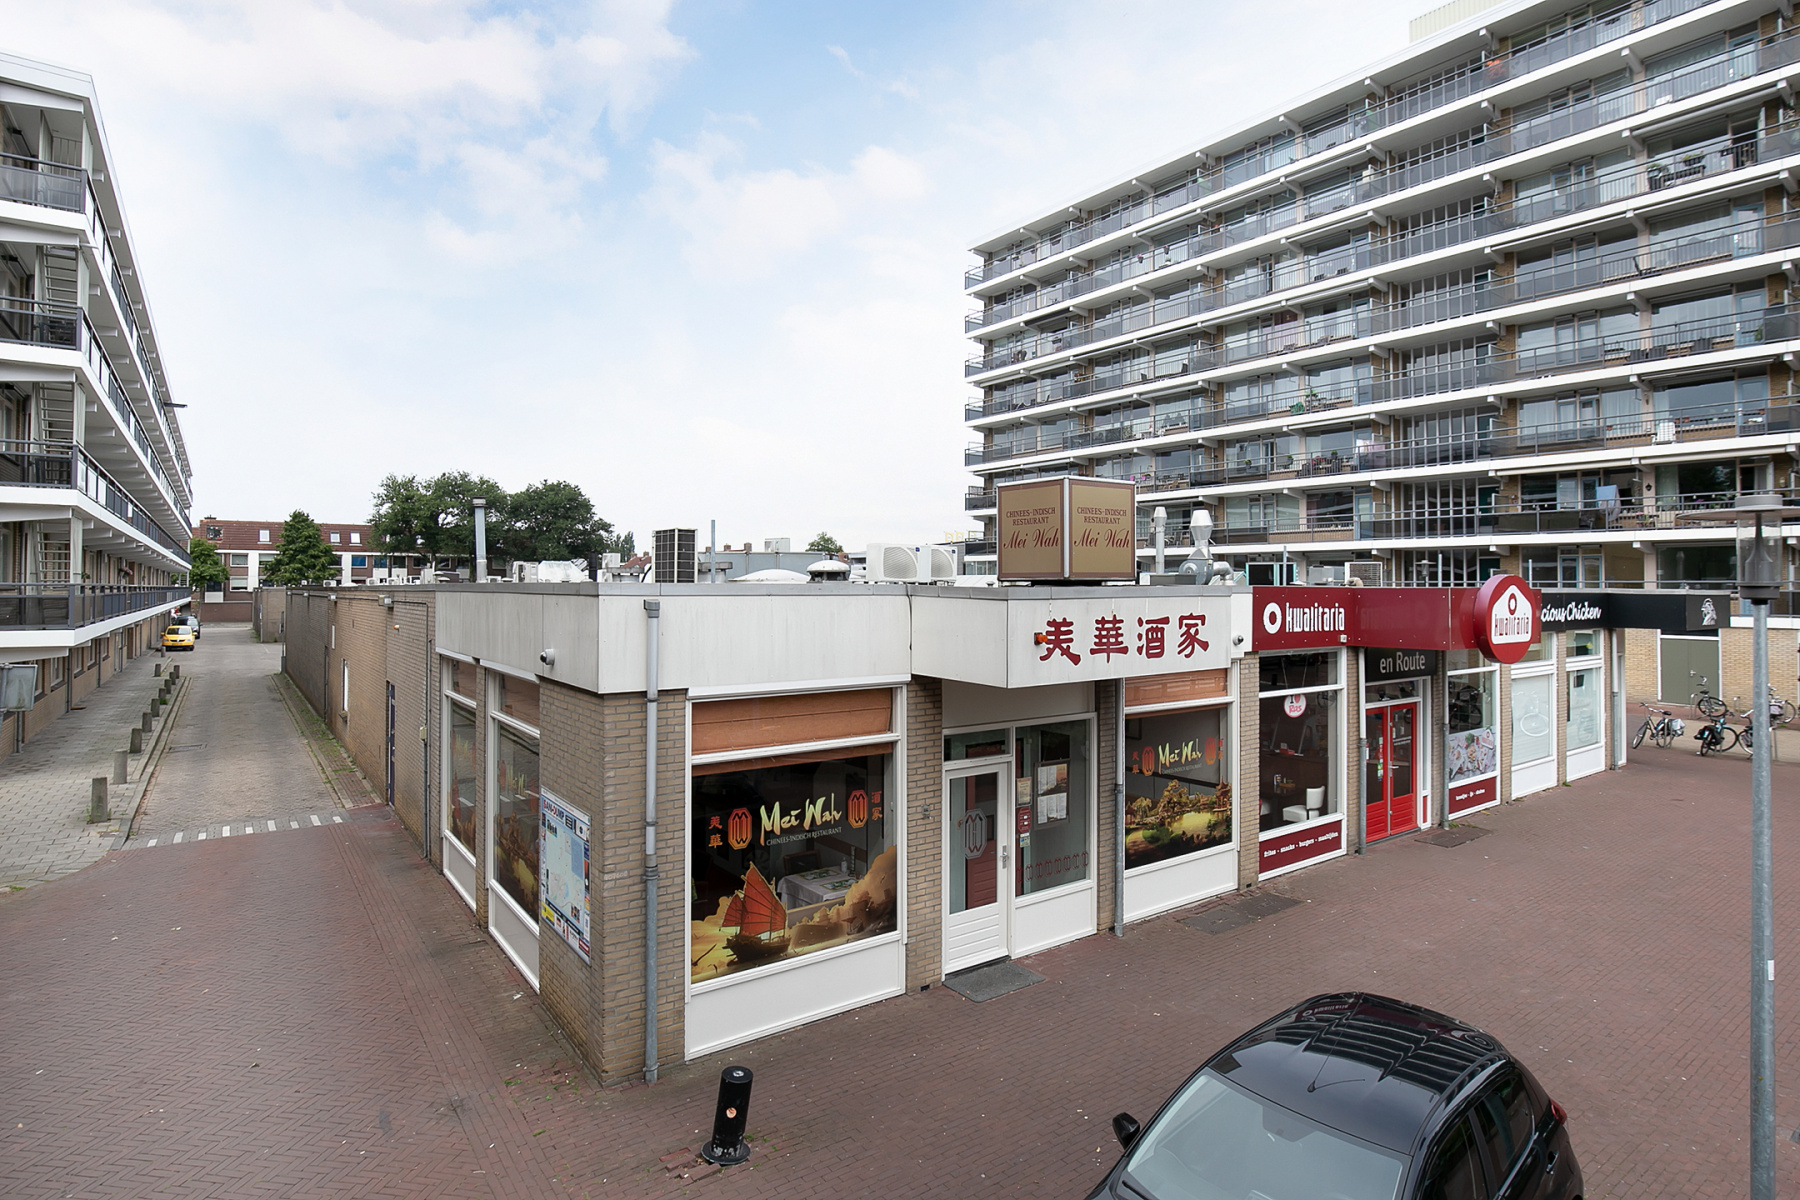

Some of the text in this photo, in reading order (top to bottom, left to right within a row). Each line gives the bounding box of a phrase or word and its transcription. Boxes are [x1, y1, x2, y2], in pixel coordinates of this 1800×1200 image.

[1005, 506, 1056, 518] CHINEES-INDISCH
[1012, 516, 1050, 526] RESTAURANT
[1076, 506, 1127, 517] CHINEES-INDISCH
[1084, 516, 1121, 525] RESTAURANT
[1003, 526, 1059, 550] Mei Wah
[1074, 527, 1130, 548] Mei Wah
[1285, 602, 1345, 633] kwalitaria
[1566, 601, 1602, 621] Chicken
[1494, 612, 1530, 636] kwalitaria
[1380, 652, 1426, 674] en Route
[760, 792, 843, 846] Mei Wah
[812, 826, 843, 839] RESTAURANT
